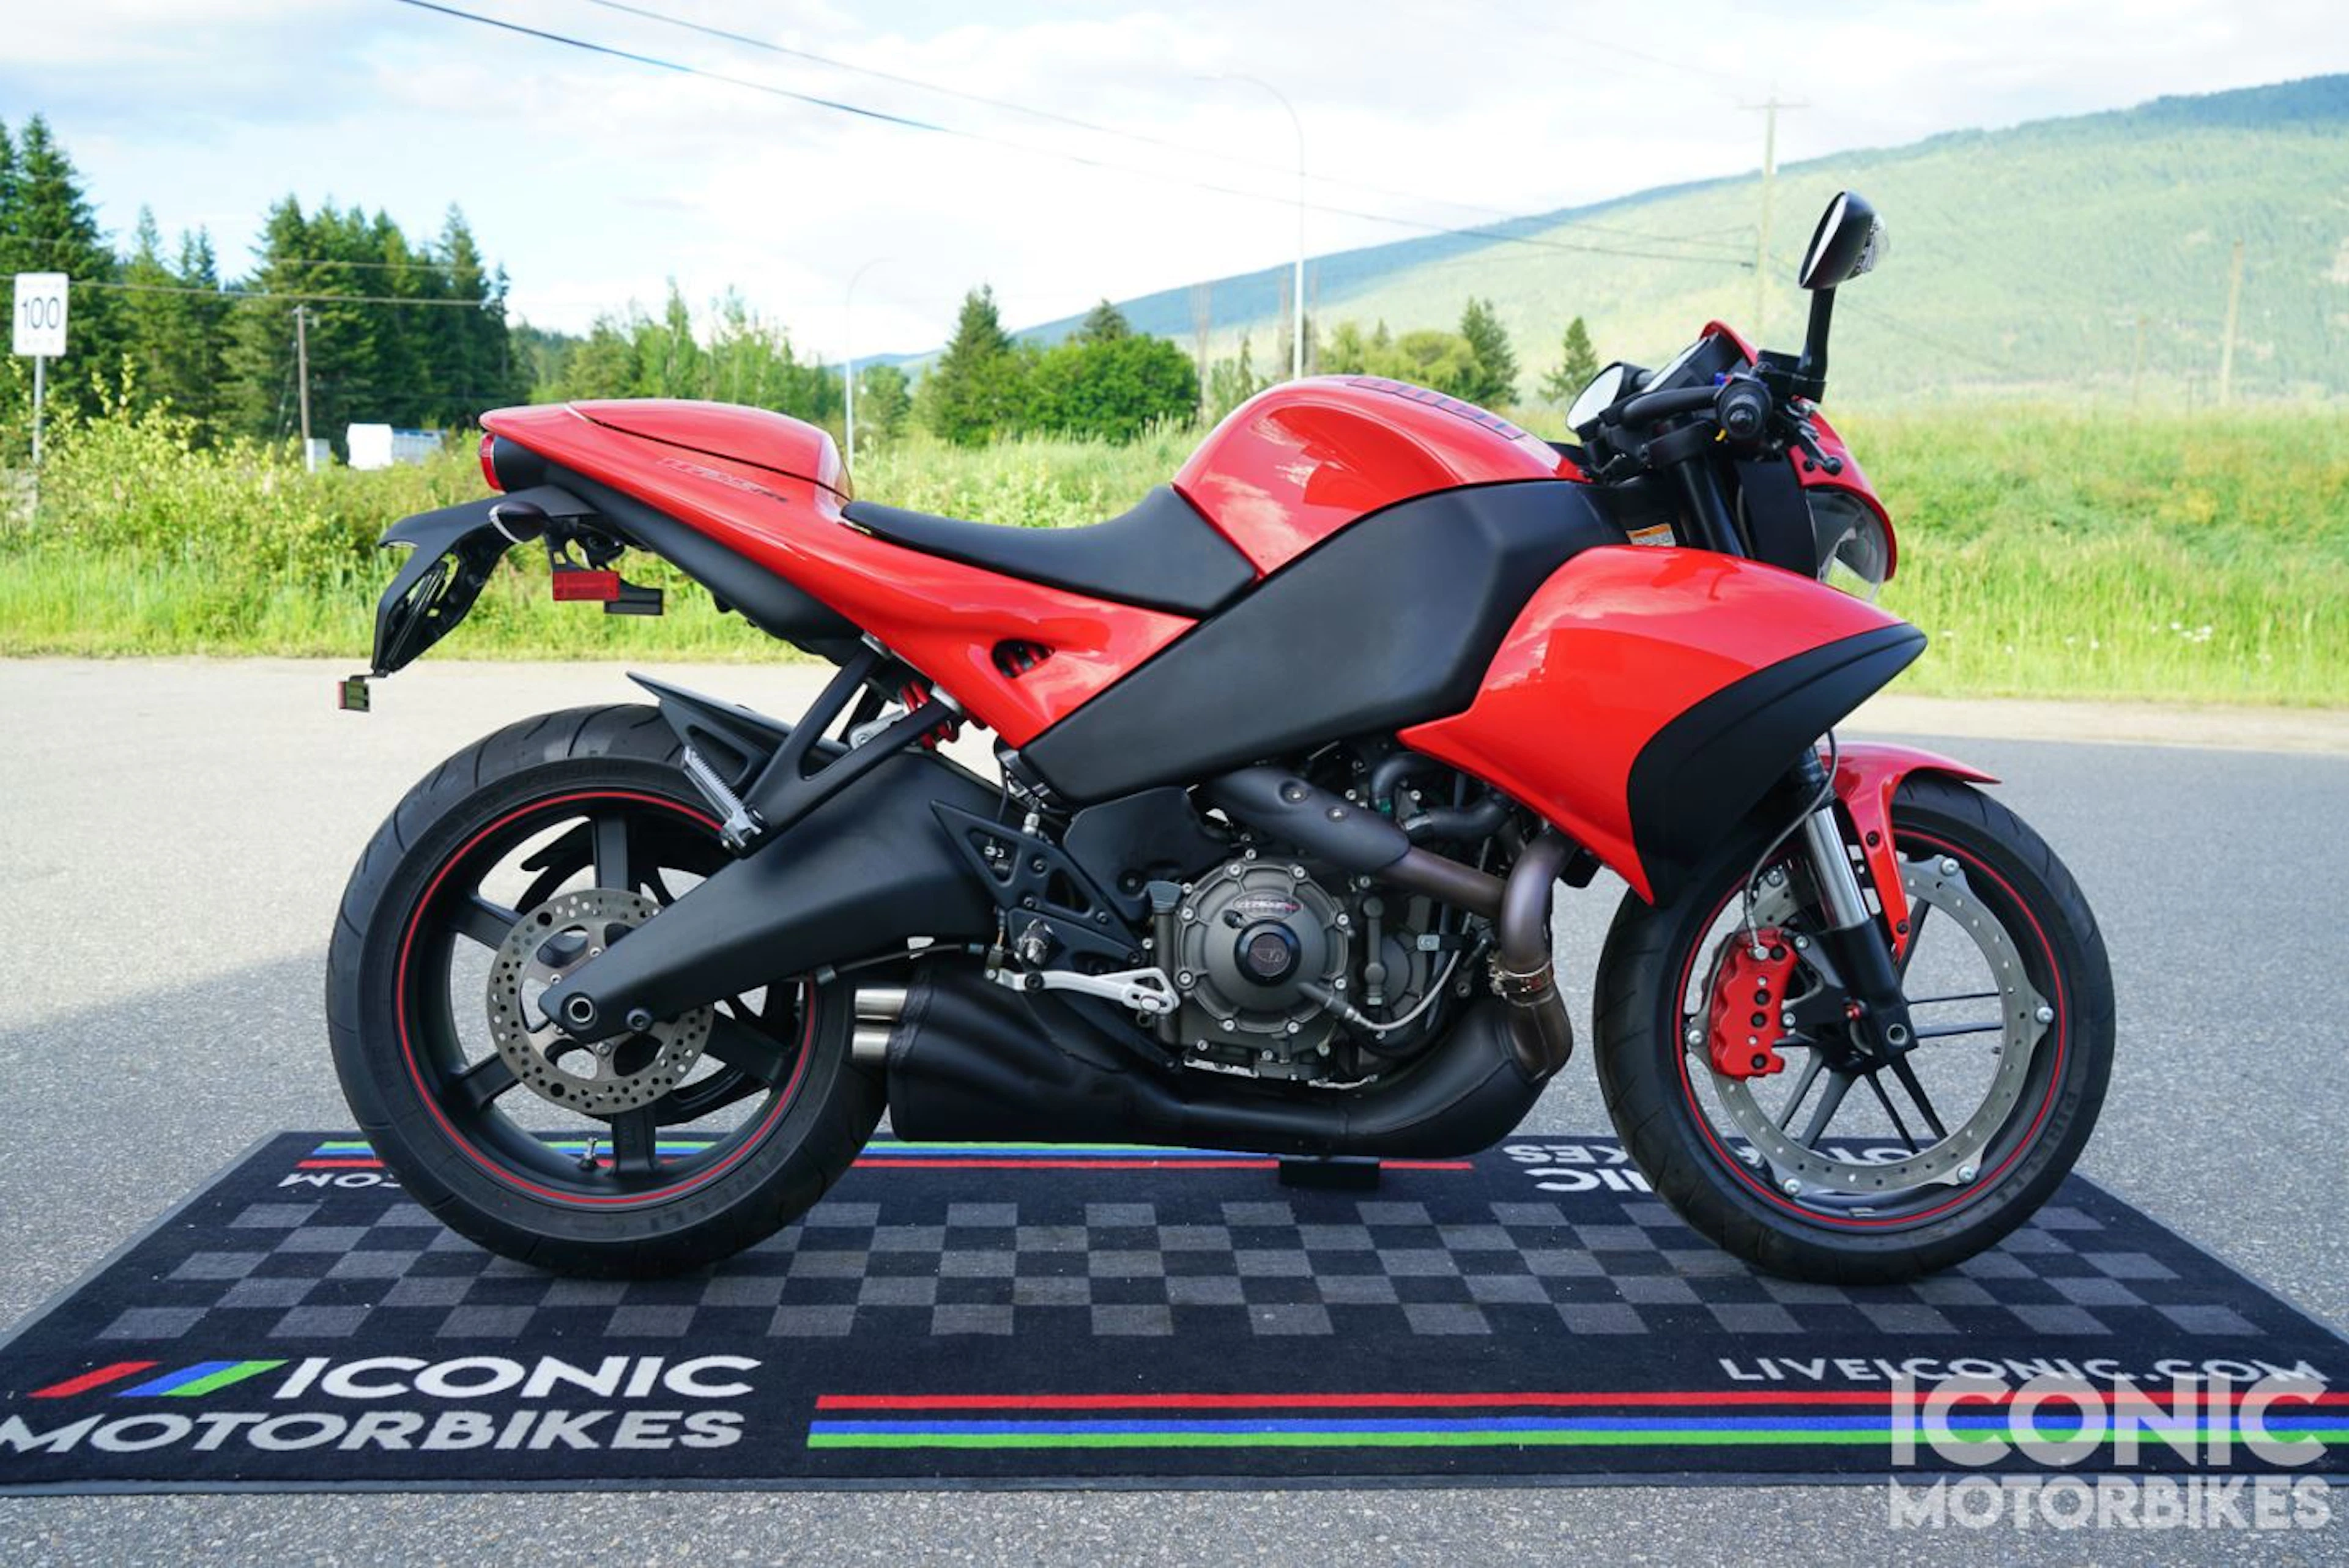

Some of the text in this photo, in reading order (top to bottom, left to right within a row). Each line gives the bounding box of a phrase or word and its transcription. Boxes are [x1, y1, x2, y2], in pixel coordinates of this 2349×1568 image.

[22, 297, 61, 330] 100
[273, 1355, 762, 1398] ICONIC
[1719, 1357, 2331, 1382] LIVEICONIC.COM
[0, 1410, 745, 1452] MOTORBIKES
